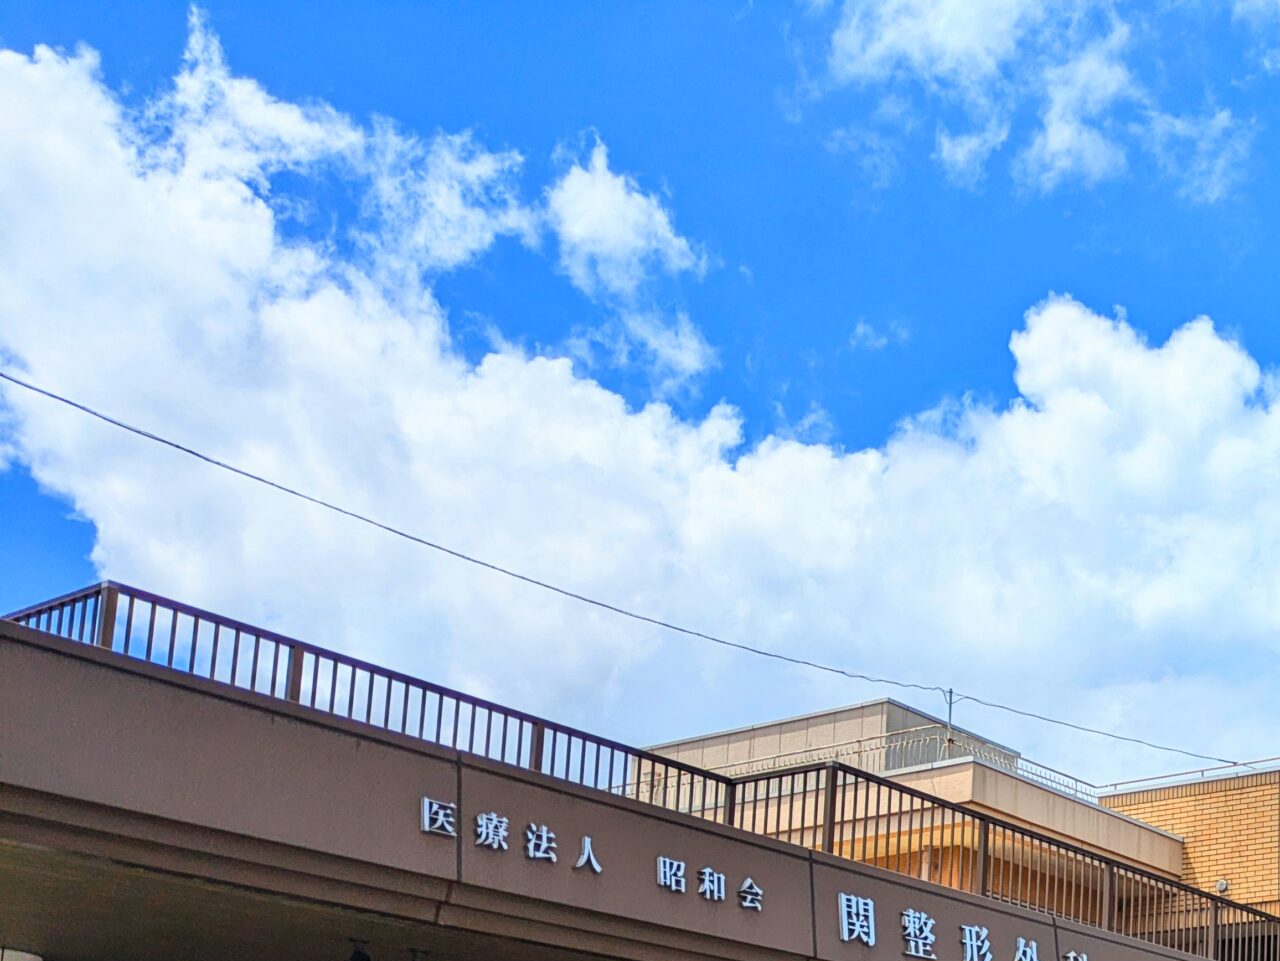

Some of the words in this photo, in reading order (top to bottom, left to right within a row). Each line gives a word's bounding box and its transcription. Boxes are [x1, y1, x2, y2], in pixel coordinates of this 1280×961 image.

[420, 795, 603, 875] 医療法人
[656, 854, 765, 911] 昭和会
